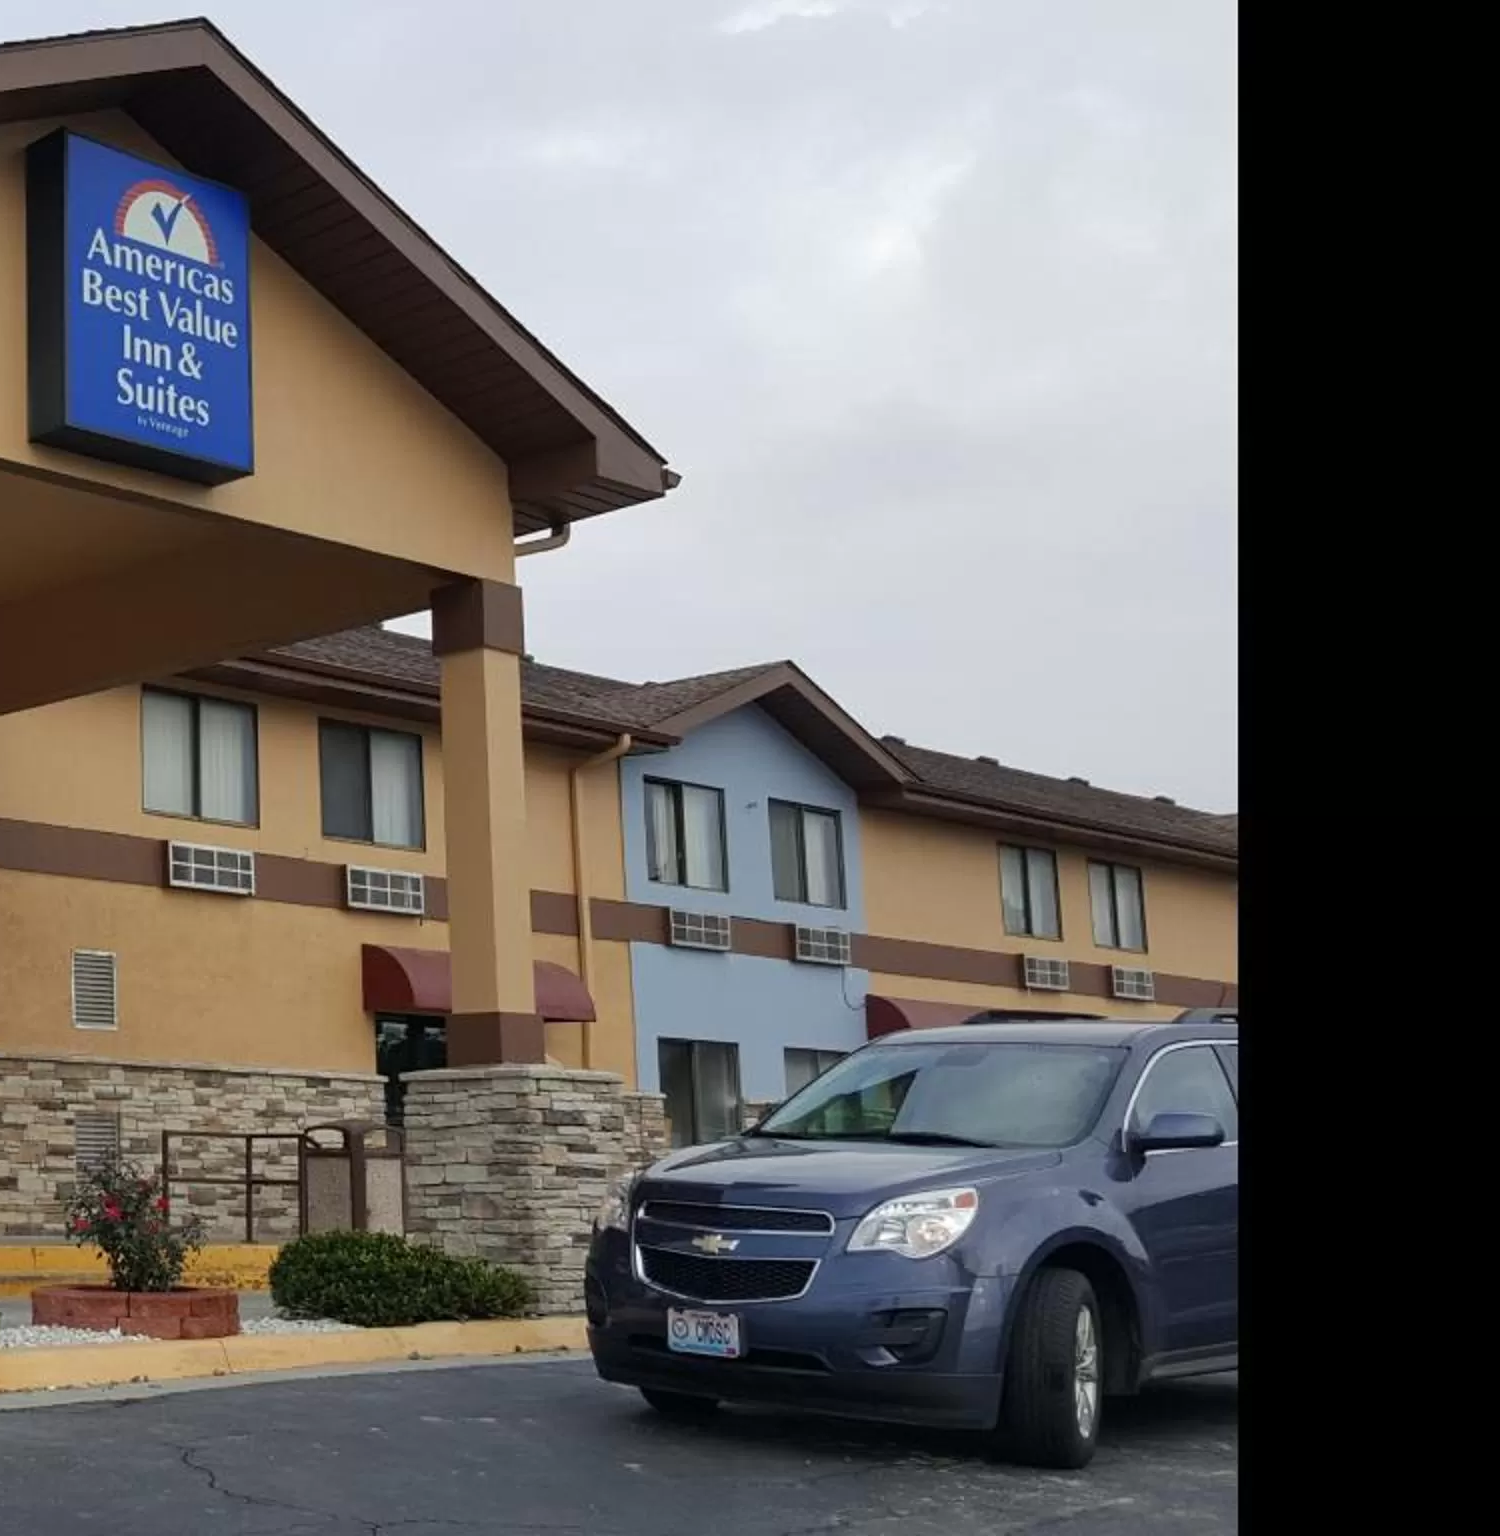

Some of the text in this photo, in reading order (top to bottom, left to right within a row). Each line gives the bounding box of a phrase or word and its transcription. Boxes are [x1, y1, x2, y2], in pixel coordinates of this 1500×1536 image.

[87, 227, 234, 305] Americas
[82, 267, 239, 349] Best Value
[123, 324, 203, 381] Inn &
[117, 367, 210, 427] Suites
